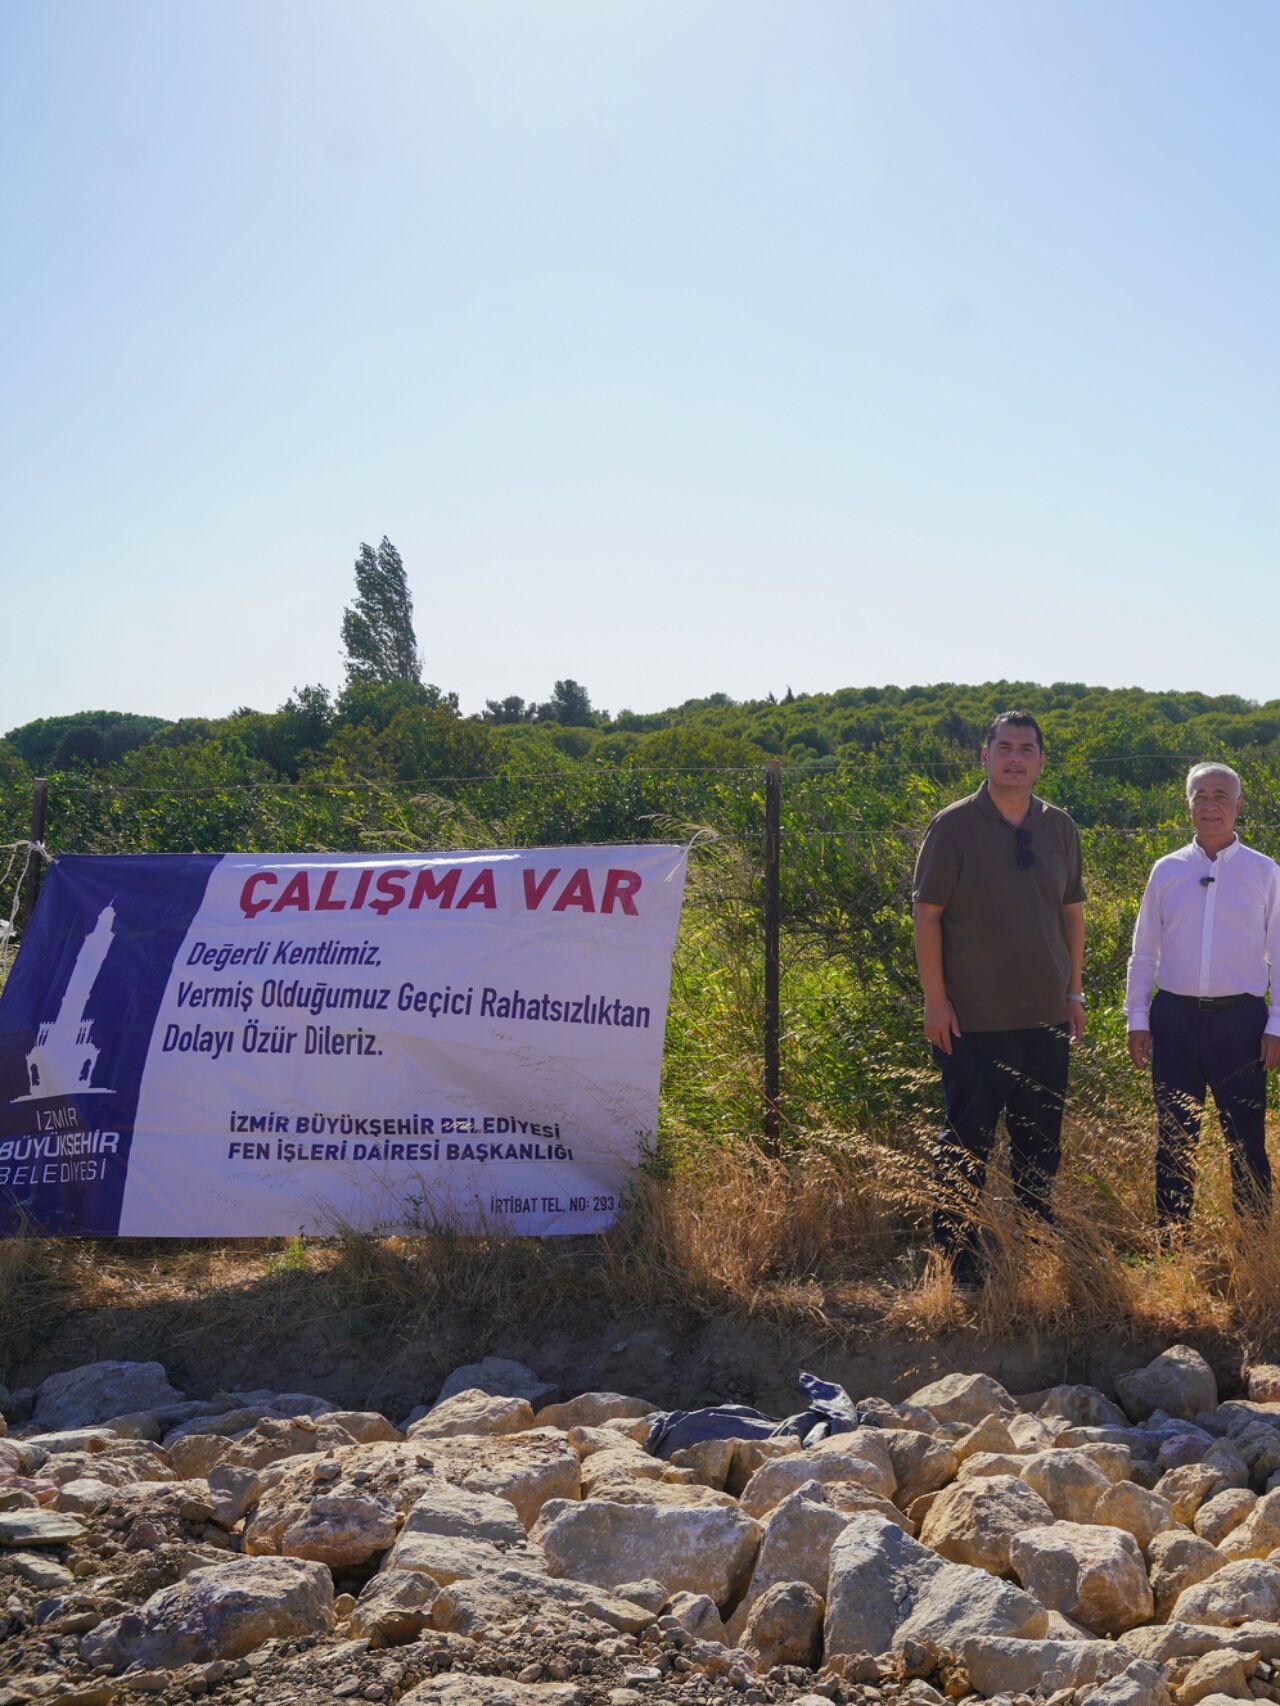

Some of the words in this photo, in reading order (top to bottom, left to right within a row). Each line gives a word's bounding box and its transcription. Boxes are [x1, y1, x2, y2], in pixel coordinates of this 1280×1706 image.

[239, 868, 498, 919] ÇALIŞMA
[523, 868, 643, 917] VAR
[186, 940, 271, 972] Değerli
[272, 940, 383, 967] Kentlimiz,
[177, 981, 254, 1012] Vermiş
[261, 979, 391, 1016] Olduğumuz
[397, 982, 473, 1018] Geçici
[480, 987, 650, 1028] Rahatsızlıktan
[162, 1023, 234, 1060] Dolayı
[242, 1019, 297, 1054] Özür
[304, 1025, 383, 1056] Dileriz.
[230, 1111, 289, 1133] İZMİR
[296, 1113, 434, 1137] BÜYÜKŞEHİR
[441, 1116, 561, 1140] BELEDİYESİ
[0, 1128, 120, 1161] BÜYÜKŞEHİR
[228, 1142, 270, 1160] FEN
[277, 1138, 347, 1163] İŞLERİ
[353, 1139, 439, 1161] DAİRESİ
[446, 1143, 574, 1163] BAŞKANLIĞI
[0, 1158, 106, 1185] BELEDİYESİ
[490, 1195, 538, 1214] İRTİBAT
[542, 1197, 566, 1212] TEL.
[569, 1197, 590, 1212] NO:
[593, 1196, 615, 1211] 293
